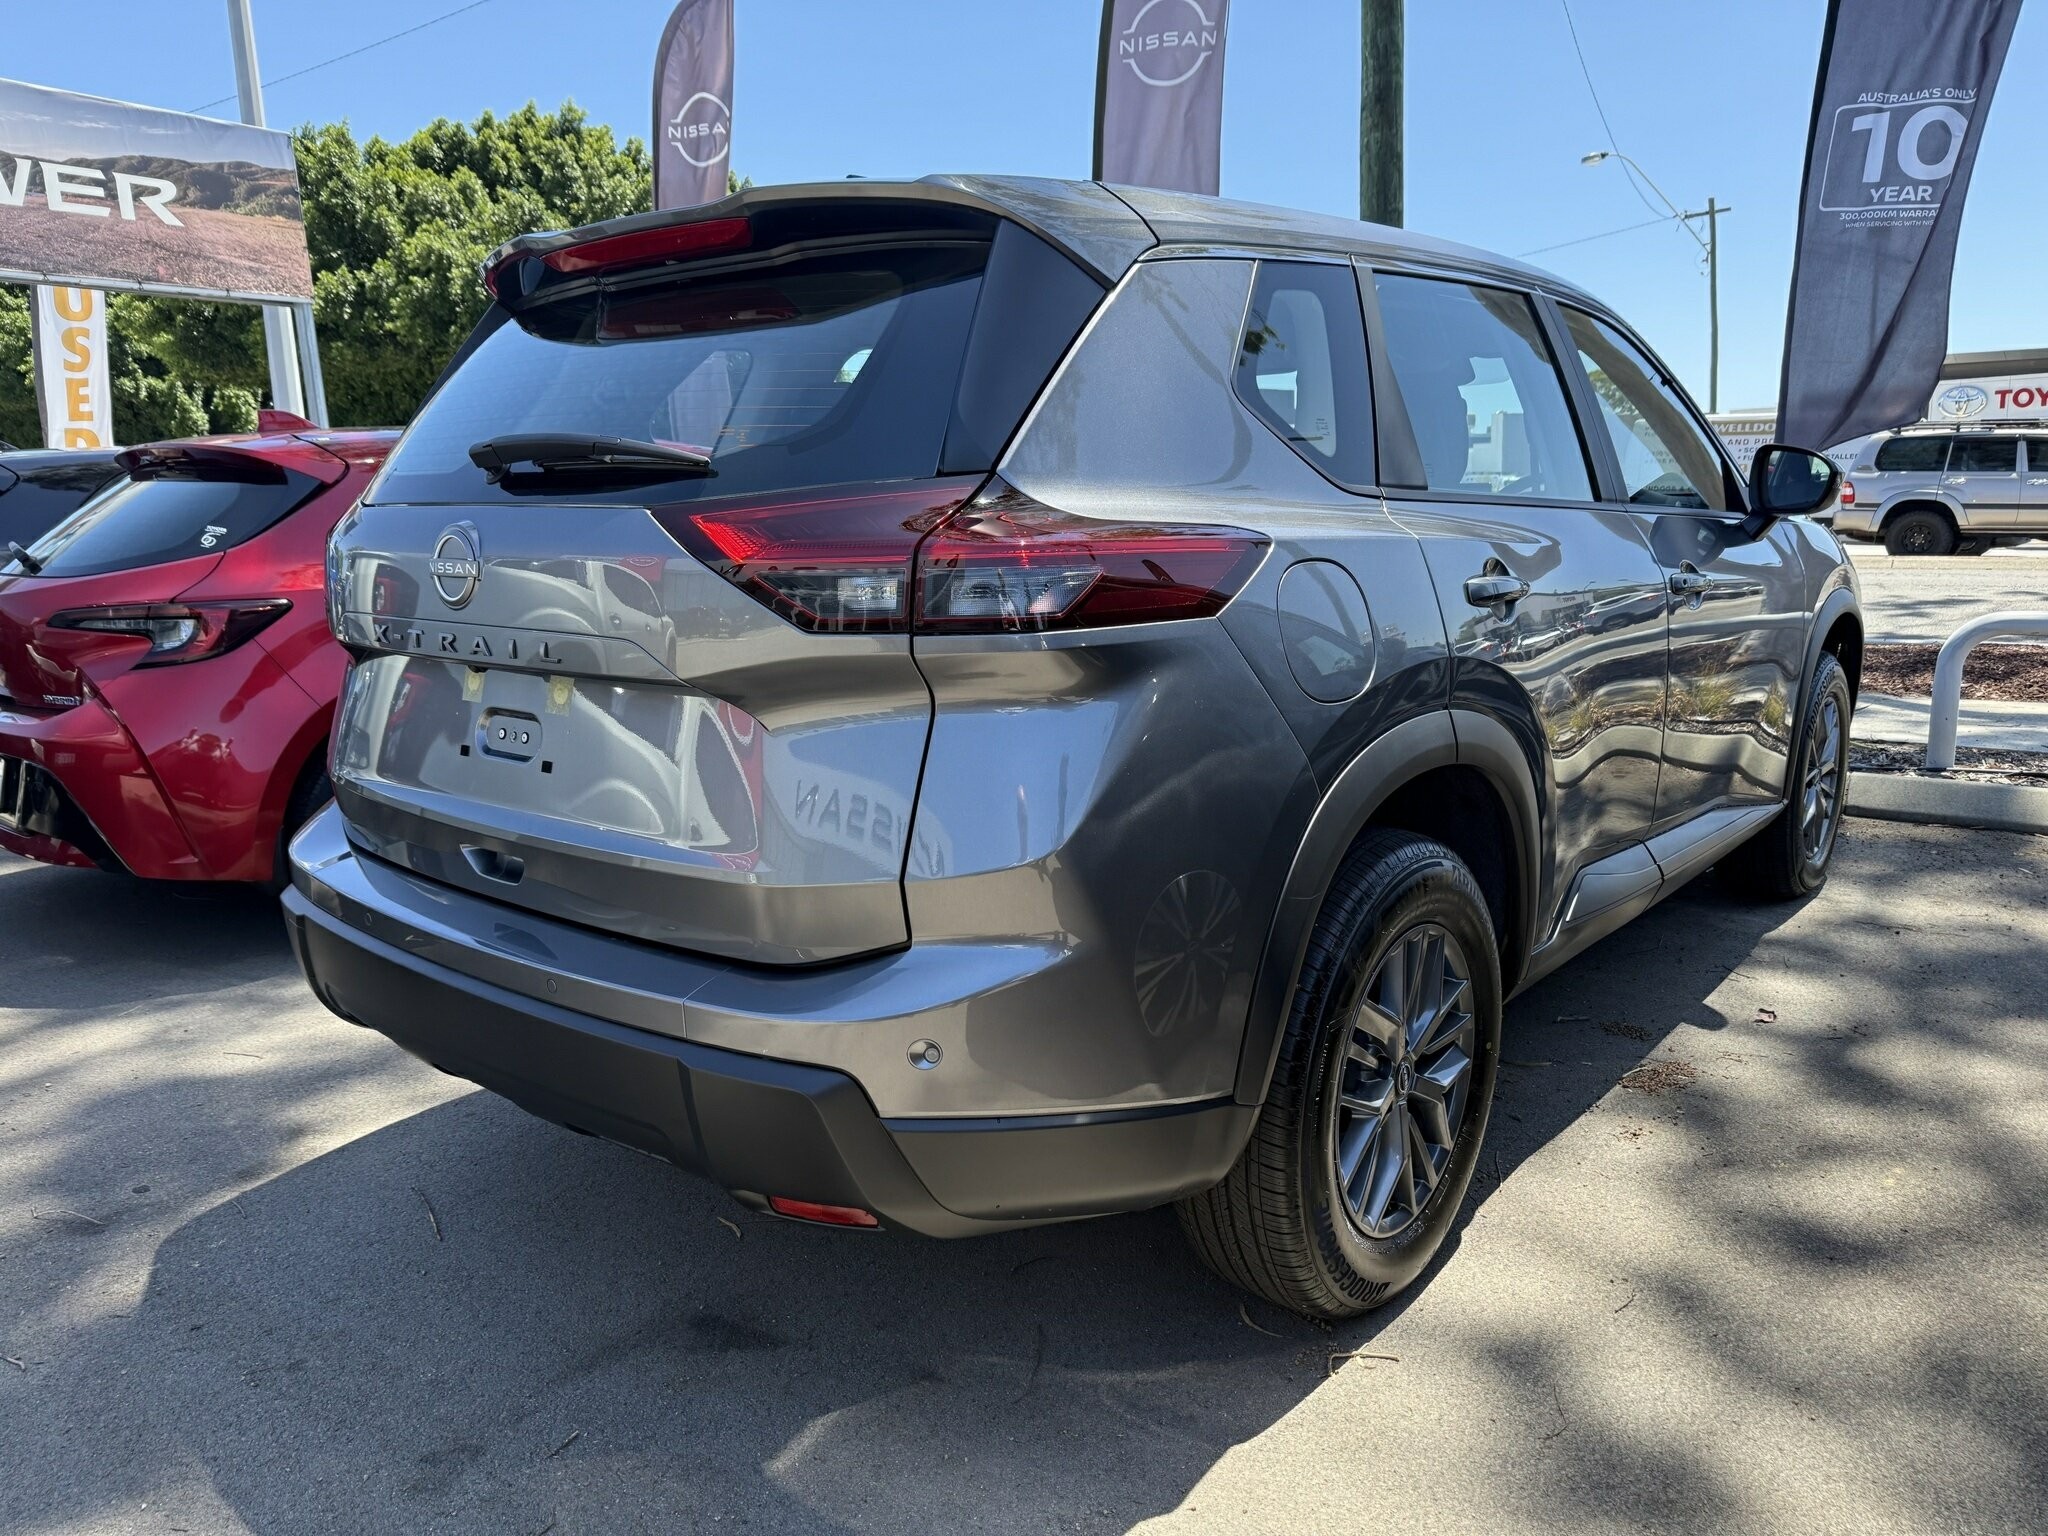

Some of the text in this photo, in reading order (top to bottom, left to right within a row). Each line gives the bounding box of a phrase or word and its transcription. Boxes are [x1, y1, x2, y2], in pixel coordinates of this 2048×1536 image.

[1120, 30, 1217, 55] NISSAN
[1857, 87, 1978, 104] AUSTRALIA'S ONLY
[668, 121, 730, 139] NISSA
[1851, 105, 1969, 183] 10
[1869, 185, 1933, 203] YEAR
[1839, 210, 1897, 221] 300,000KM
[1866, 220, 1903, 228] SERVICING
[1994, 387, 2048, 410] TOY
[1727, 438, 1750, 446] AND
[429, 561, 477, 575] NISSAN
[374, 623, 563, 665] X-TRAIL
